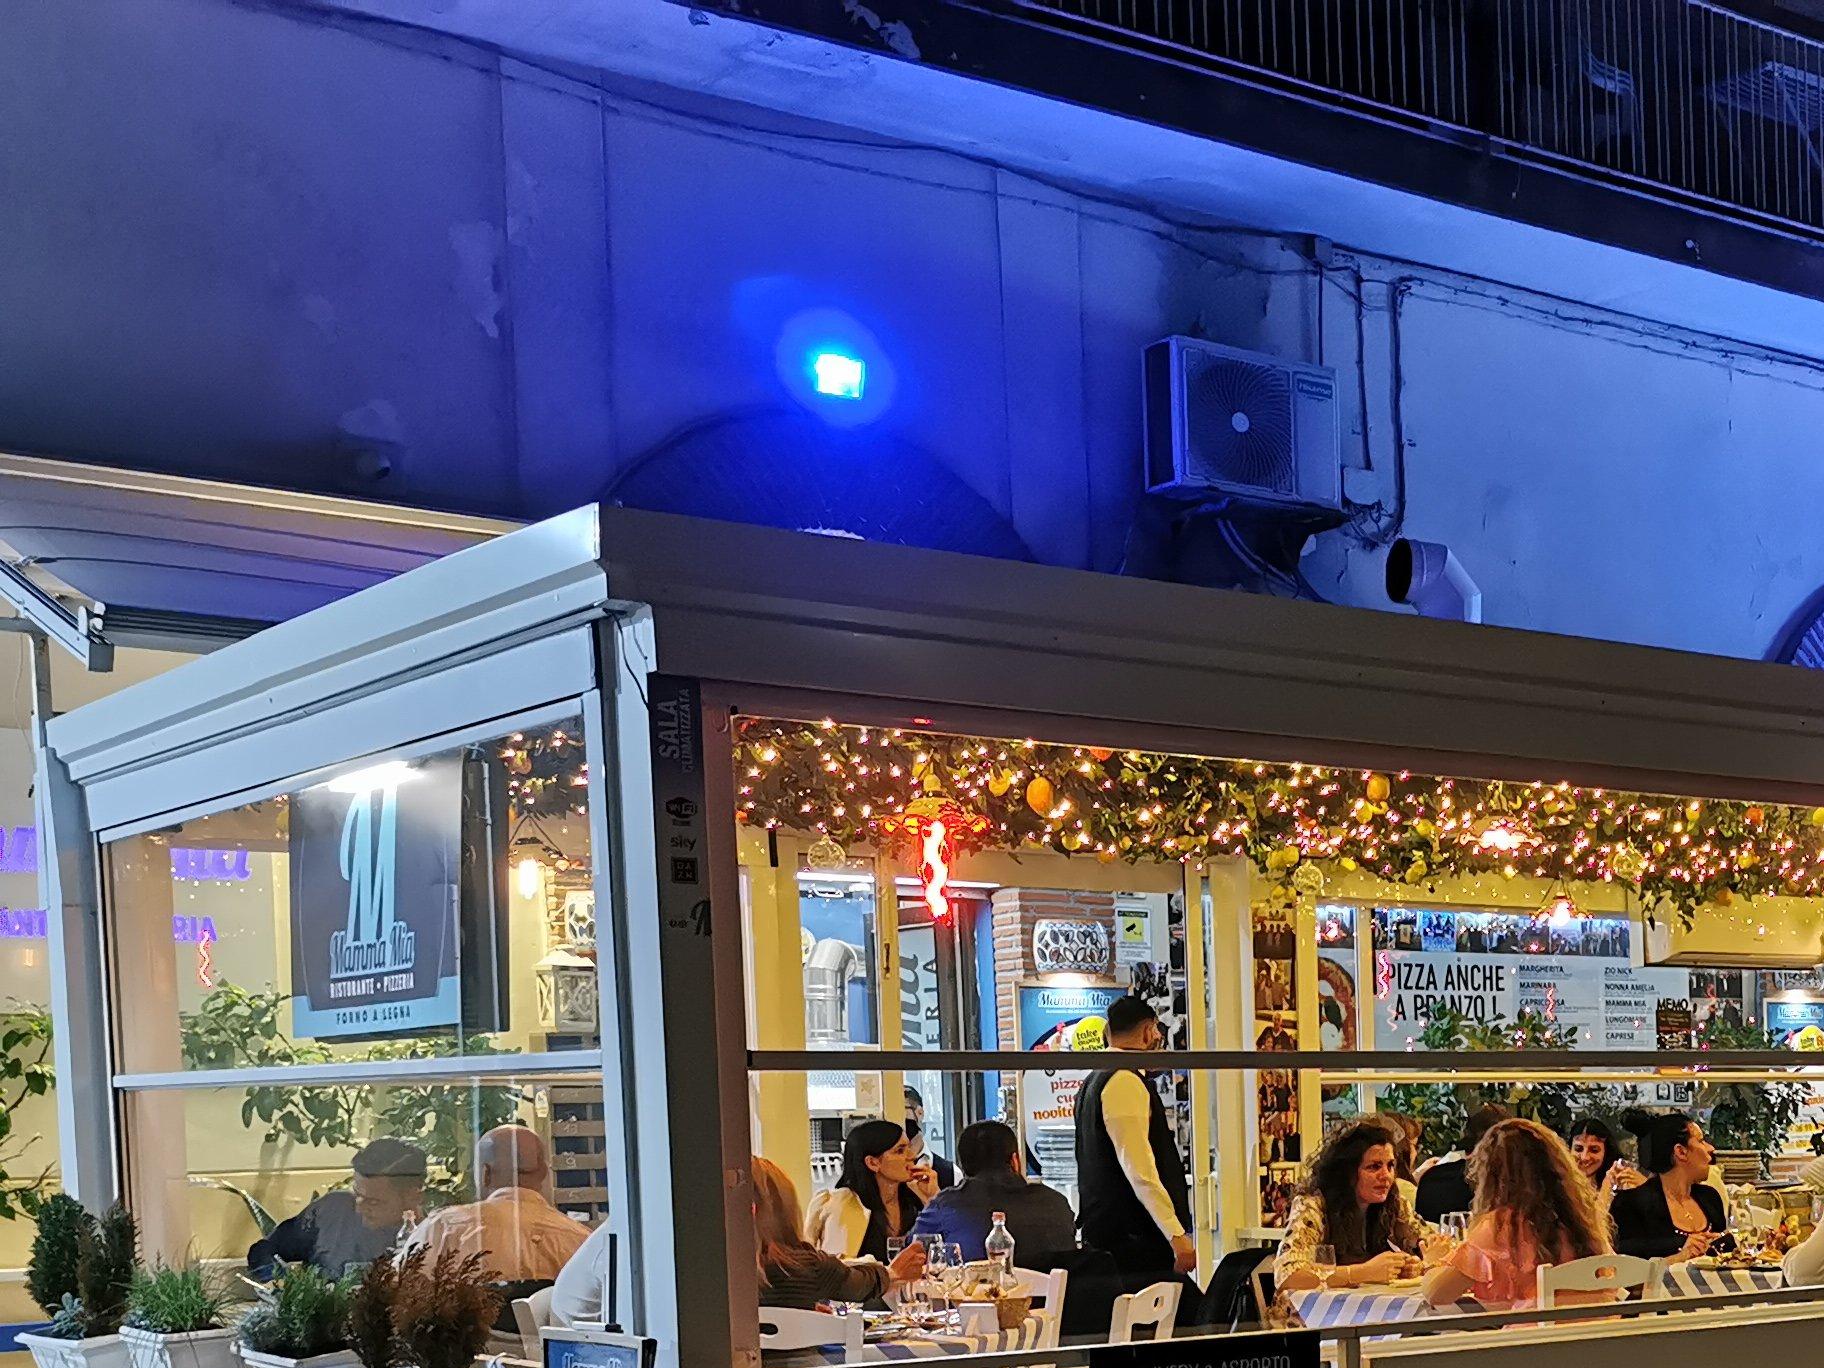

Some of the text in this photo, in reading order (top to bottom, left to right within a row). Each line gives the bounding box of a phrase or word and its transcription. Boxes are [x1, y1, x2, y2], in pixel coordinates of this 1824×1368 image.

[657, 699, 681, 760] SALA
[331, 921, 414, 976] Mamma Mia
[330, 972, 415, 999] RISTORANTE PIZZERIA
[1444, 964, 1505, 992] ANCHE
[336, 1005, 411, 1025] FORNO A LEGNA
[1395, 993, 1407, 1021] A
